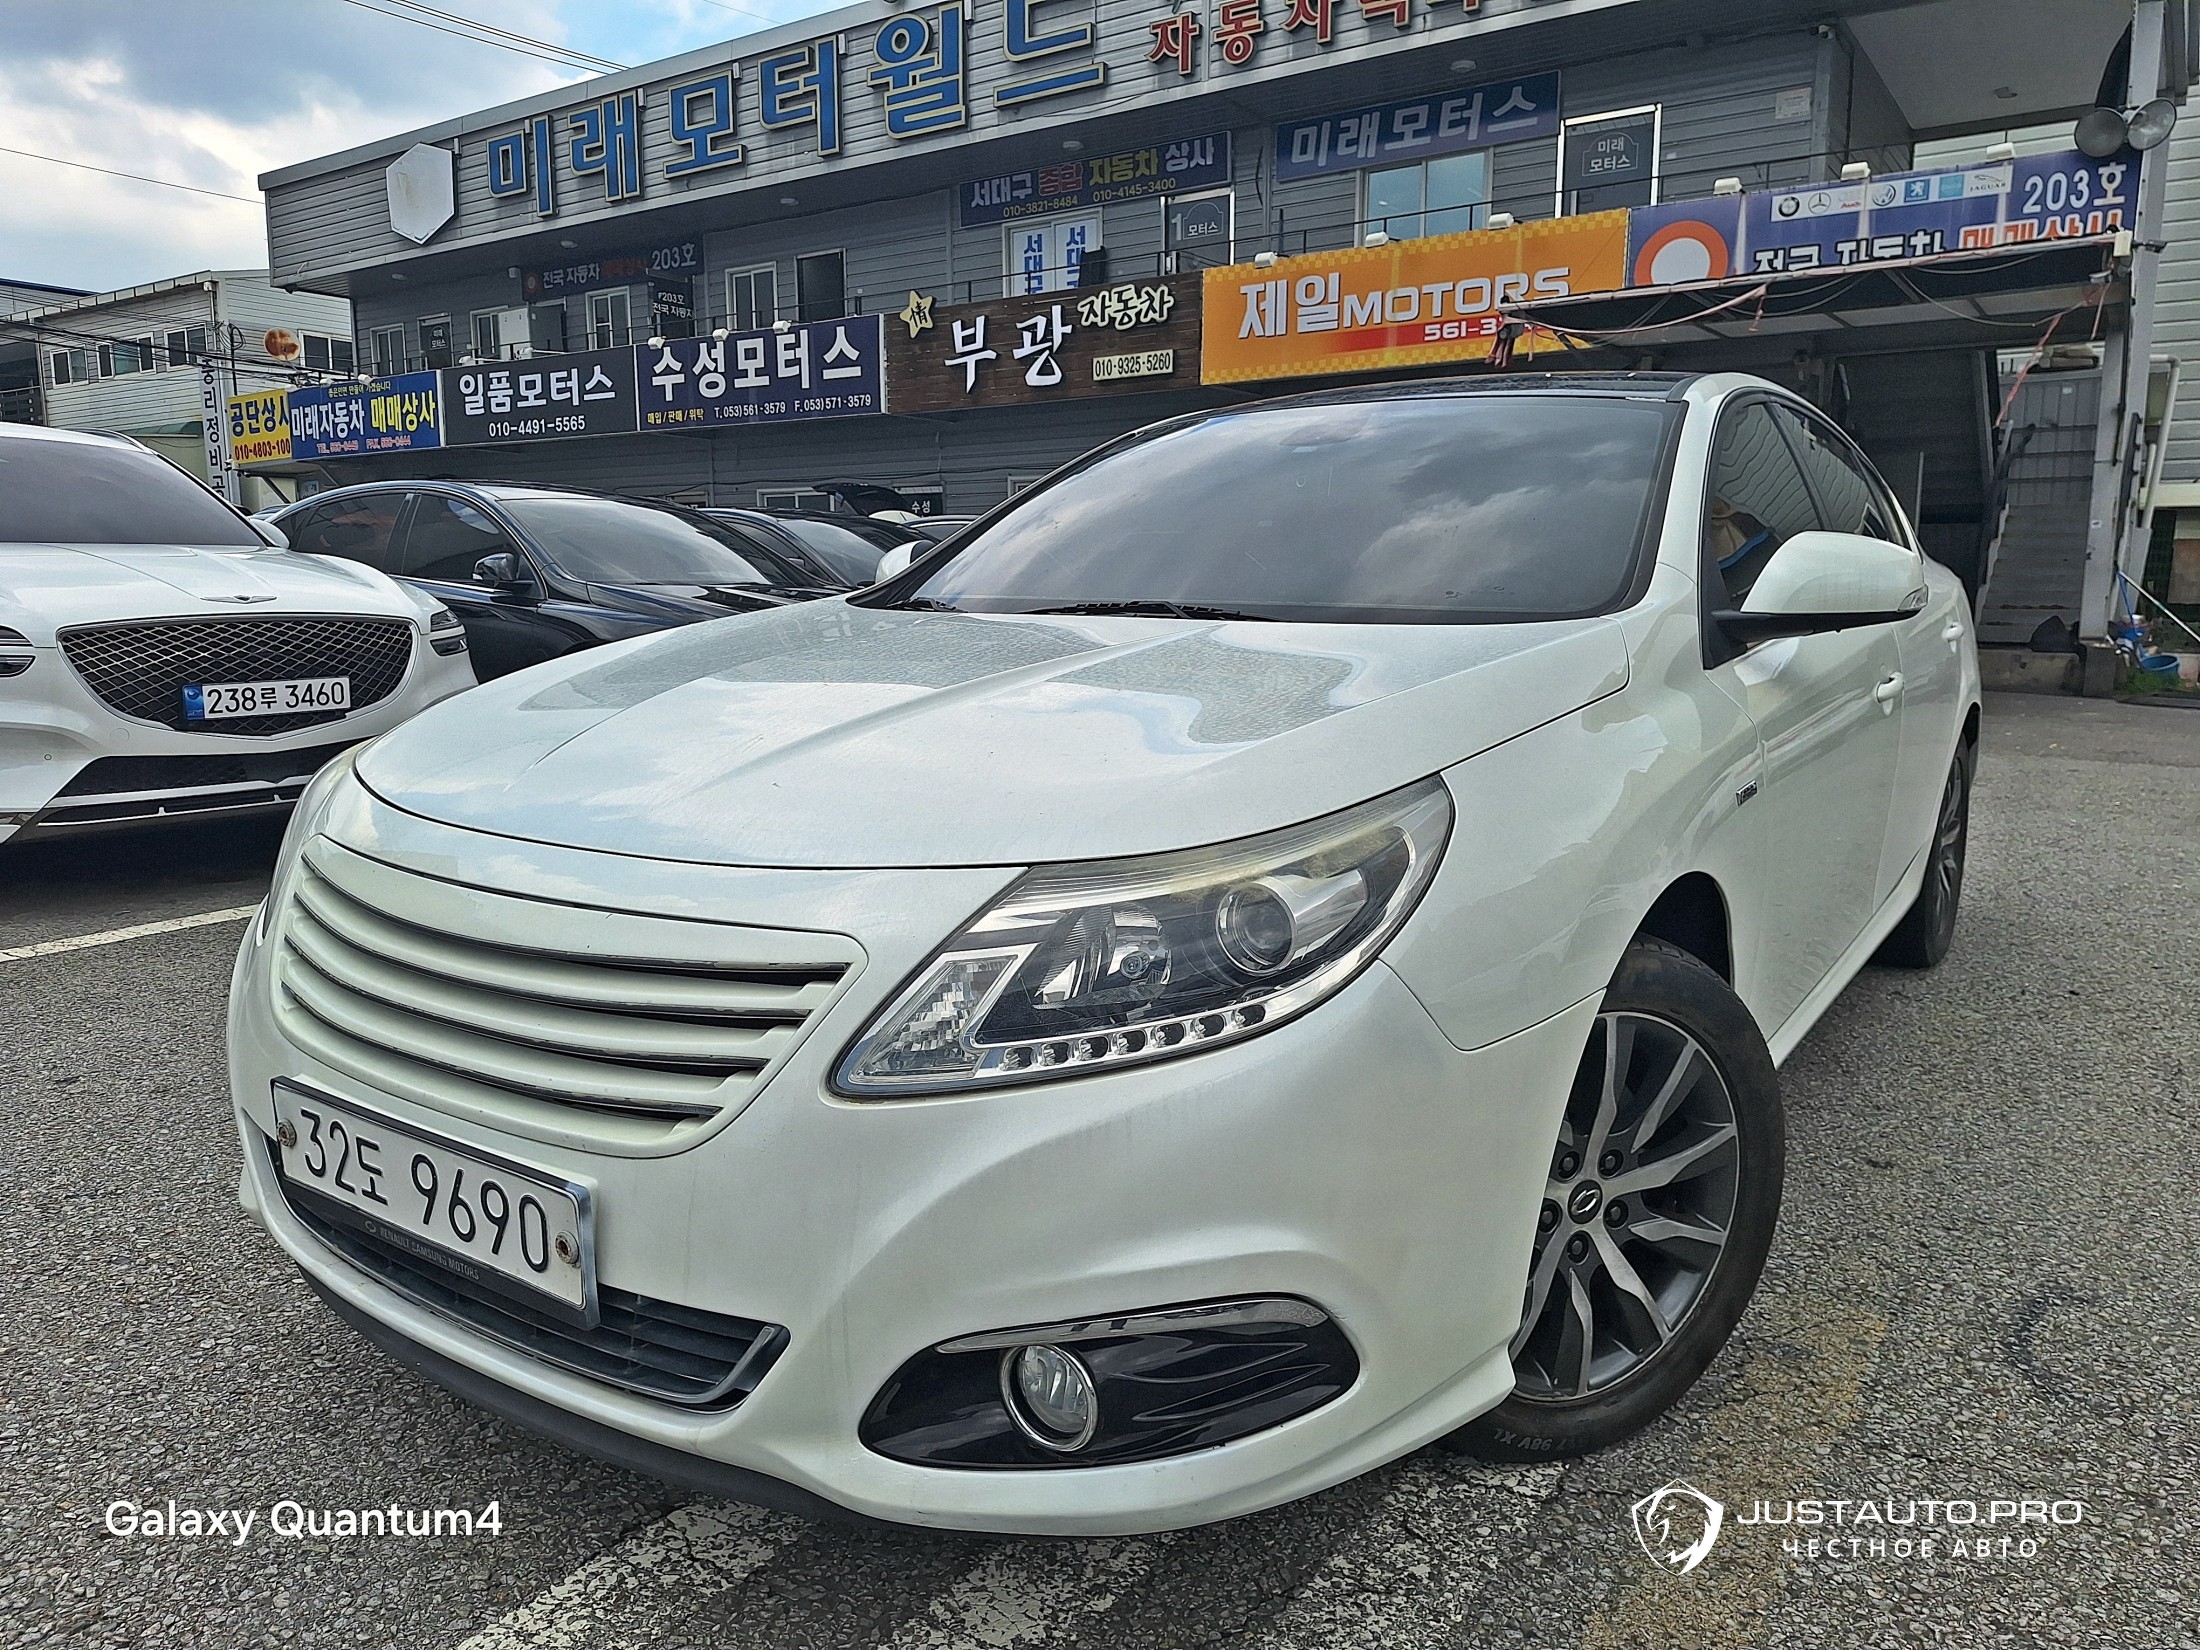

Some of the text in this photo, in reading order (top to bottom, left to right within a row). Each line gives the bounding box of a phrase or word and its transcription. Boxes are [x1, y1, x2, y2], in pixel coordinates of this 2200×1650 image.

[1290, 86, 1538, 168] 미래모터스
[1598, 136, 1624, 154] 미래
[970, 172, 1032, 208] 서대구
[1089, 148, 1158, 187] 자동차
[1165, 136, 1215, 173] 상사
[1589, 154, 1631, 172] 모터스
[1003, 177, 1177, 219] 010-3821-8484 010-4145-3400
[2022, 161, 2127, 215] 203호
[1187, 221, 1219, 237] 모터스
[652, 242, 697, 271] 203호
[1077, 284, 1175, 330] 자동차
[651, 325, 863, 402] 수성모터스
[459, 364, 616, 417] 일품모터스
[291, 390, 436, 442] 미래자동차 매매상사
[488, 415, 586, 438] 010-4491-5565
[285, 682, 345, 709] 3460
[300, 1108, 549, 1273] 32도 9690
[448, 1257, 480, 1281] MOTORS
